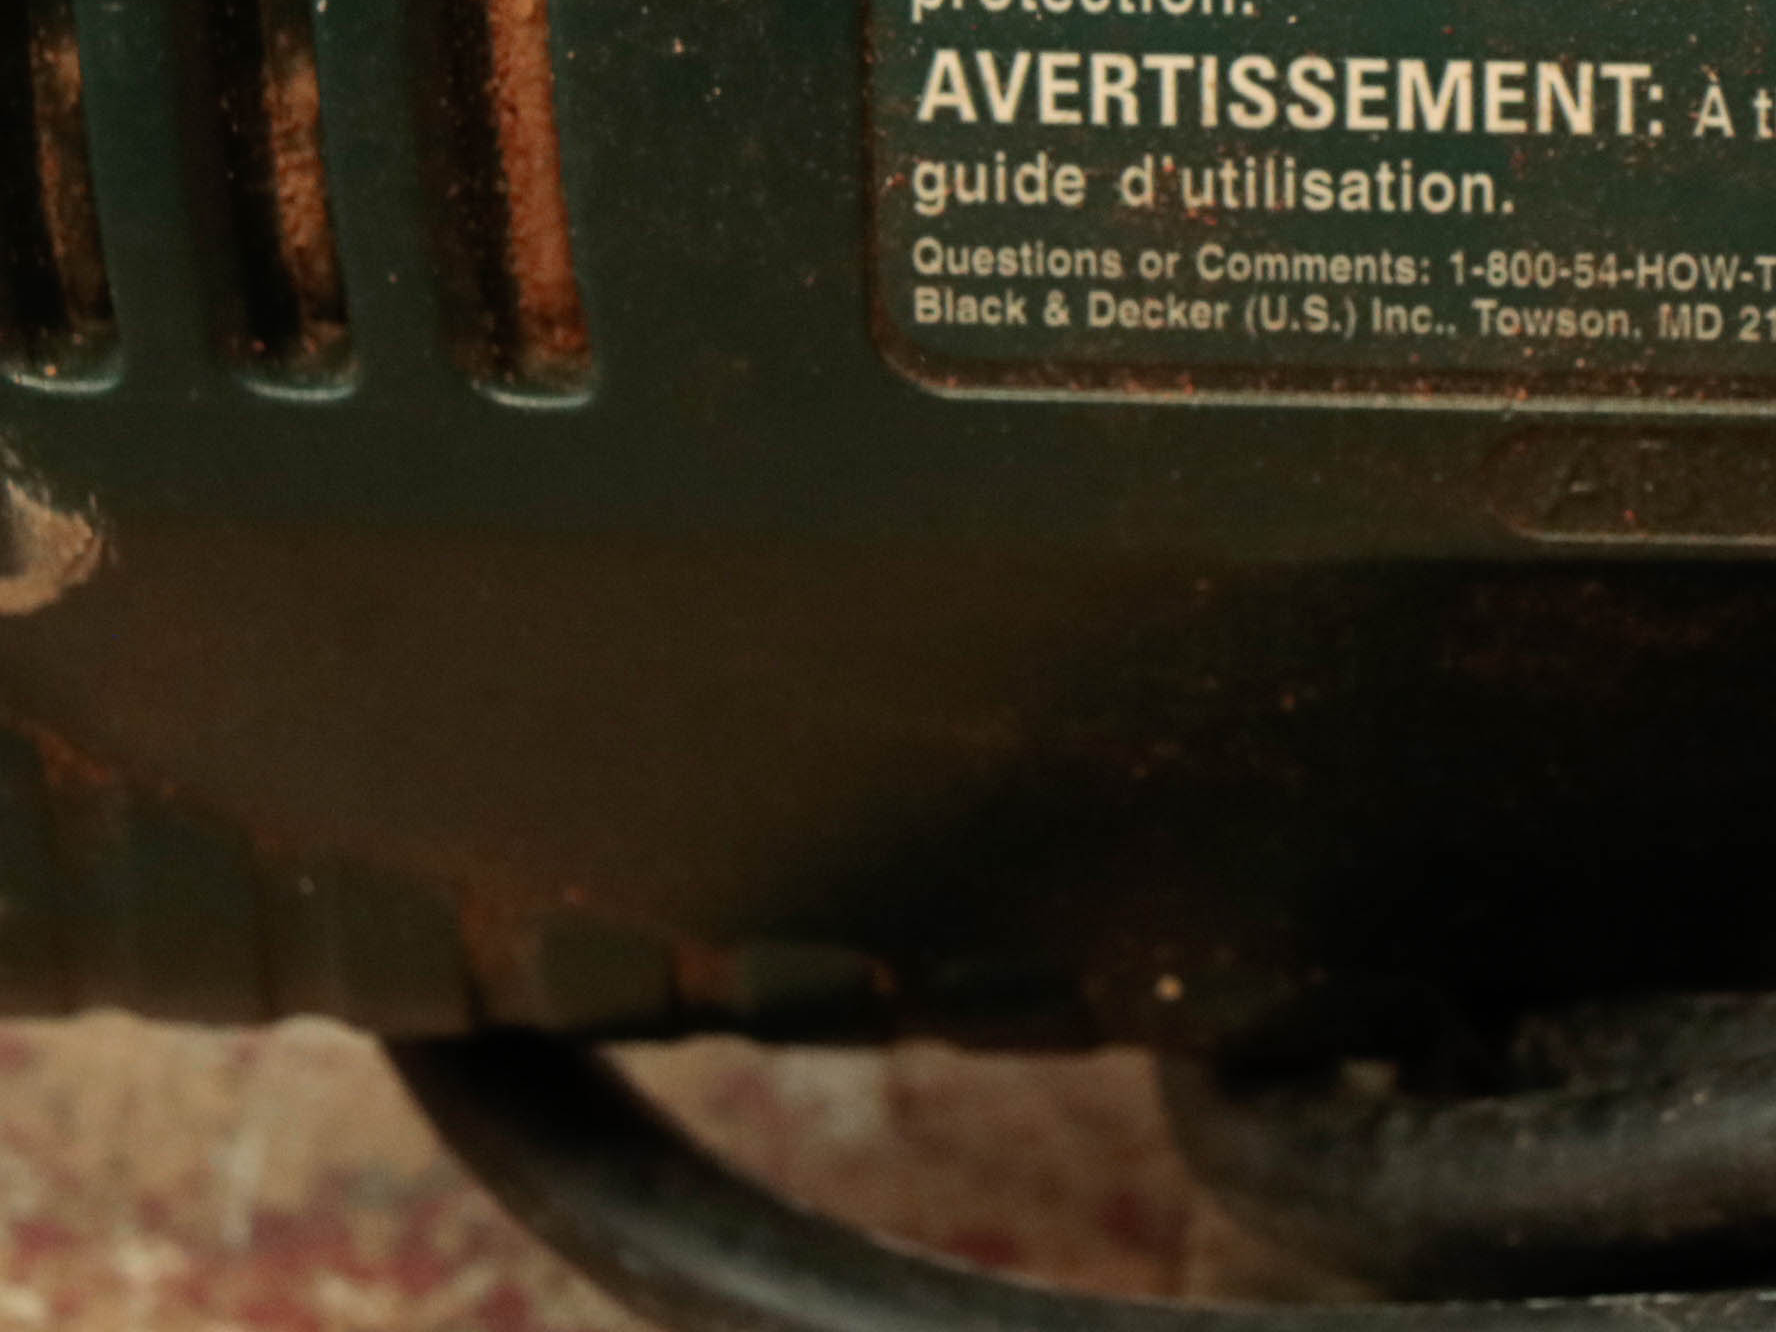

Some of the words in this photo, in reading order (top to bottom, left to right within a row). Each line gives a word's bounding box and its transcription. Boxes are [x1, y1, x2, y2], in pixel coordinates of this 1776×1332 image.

[917, 48, 1663, 136] AVERTISSEMENT:
[912, 151, 1086, 217] guide
[1118, 154, 1514, 214] d'utilisation.
[912, 235, 1123, 279] Questions
[1138, 249, 1181, 280] or
[1195, 242, 1430, 286] Comments:
[914, 286, 1027, 326] Black
[1043, 290, 1070, 327] &
[1087, 289, 1230, 330] Decker
[1244, 293, 1357, 337] (U.S.)
[1659, 303, 1723, 341] MD
